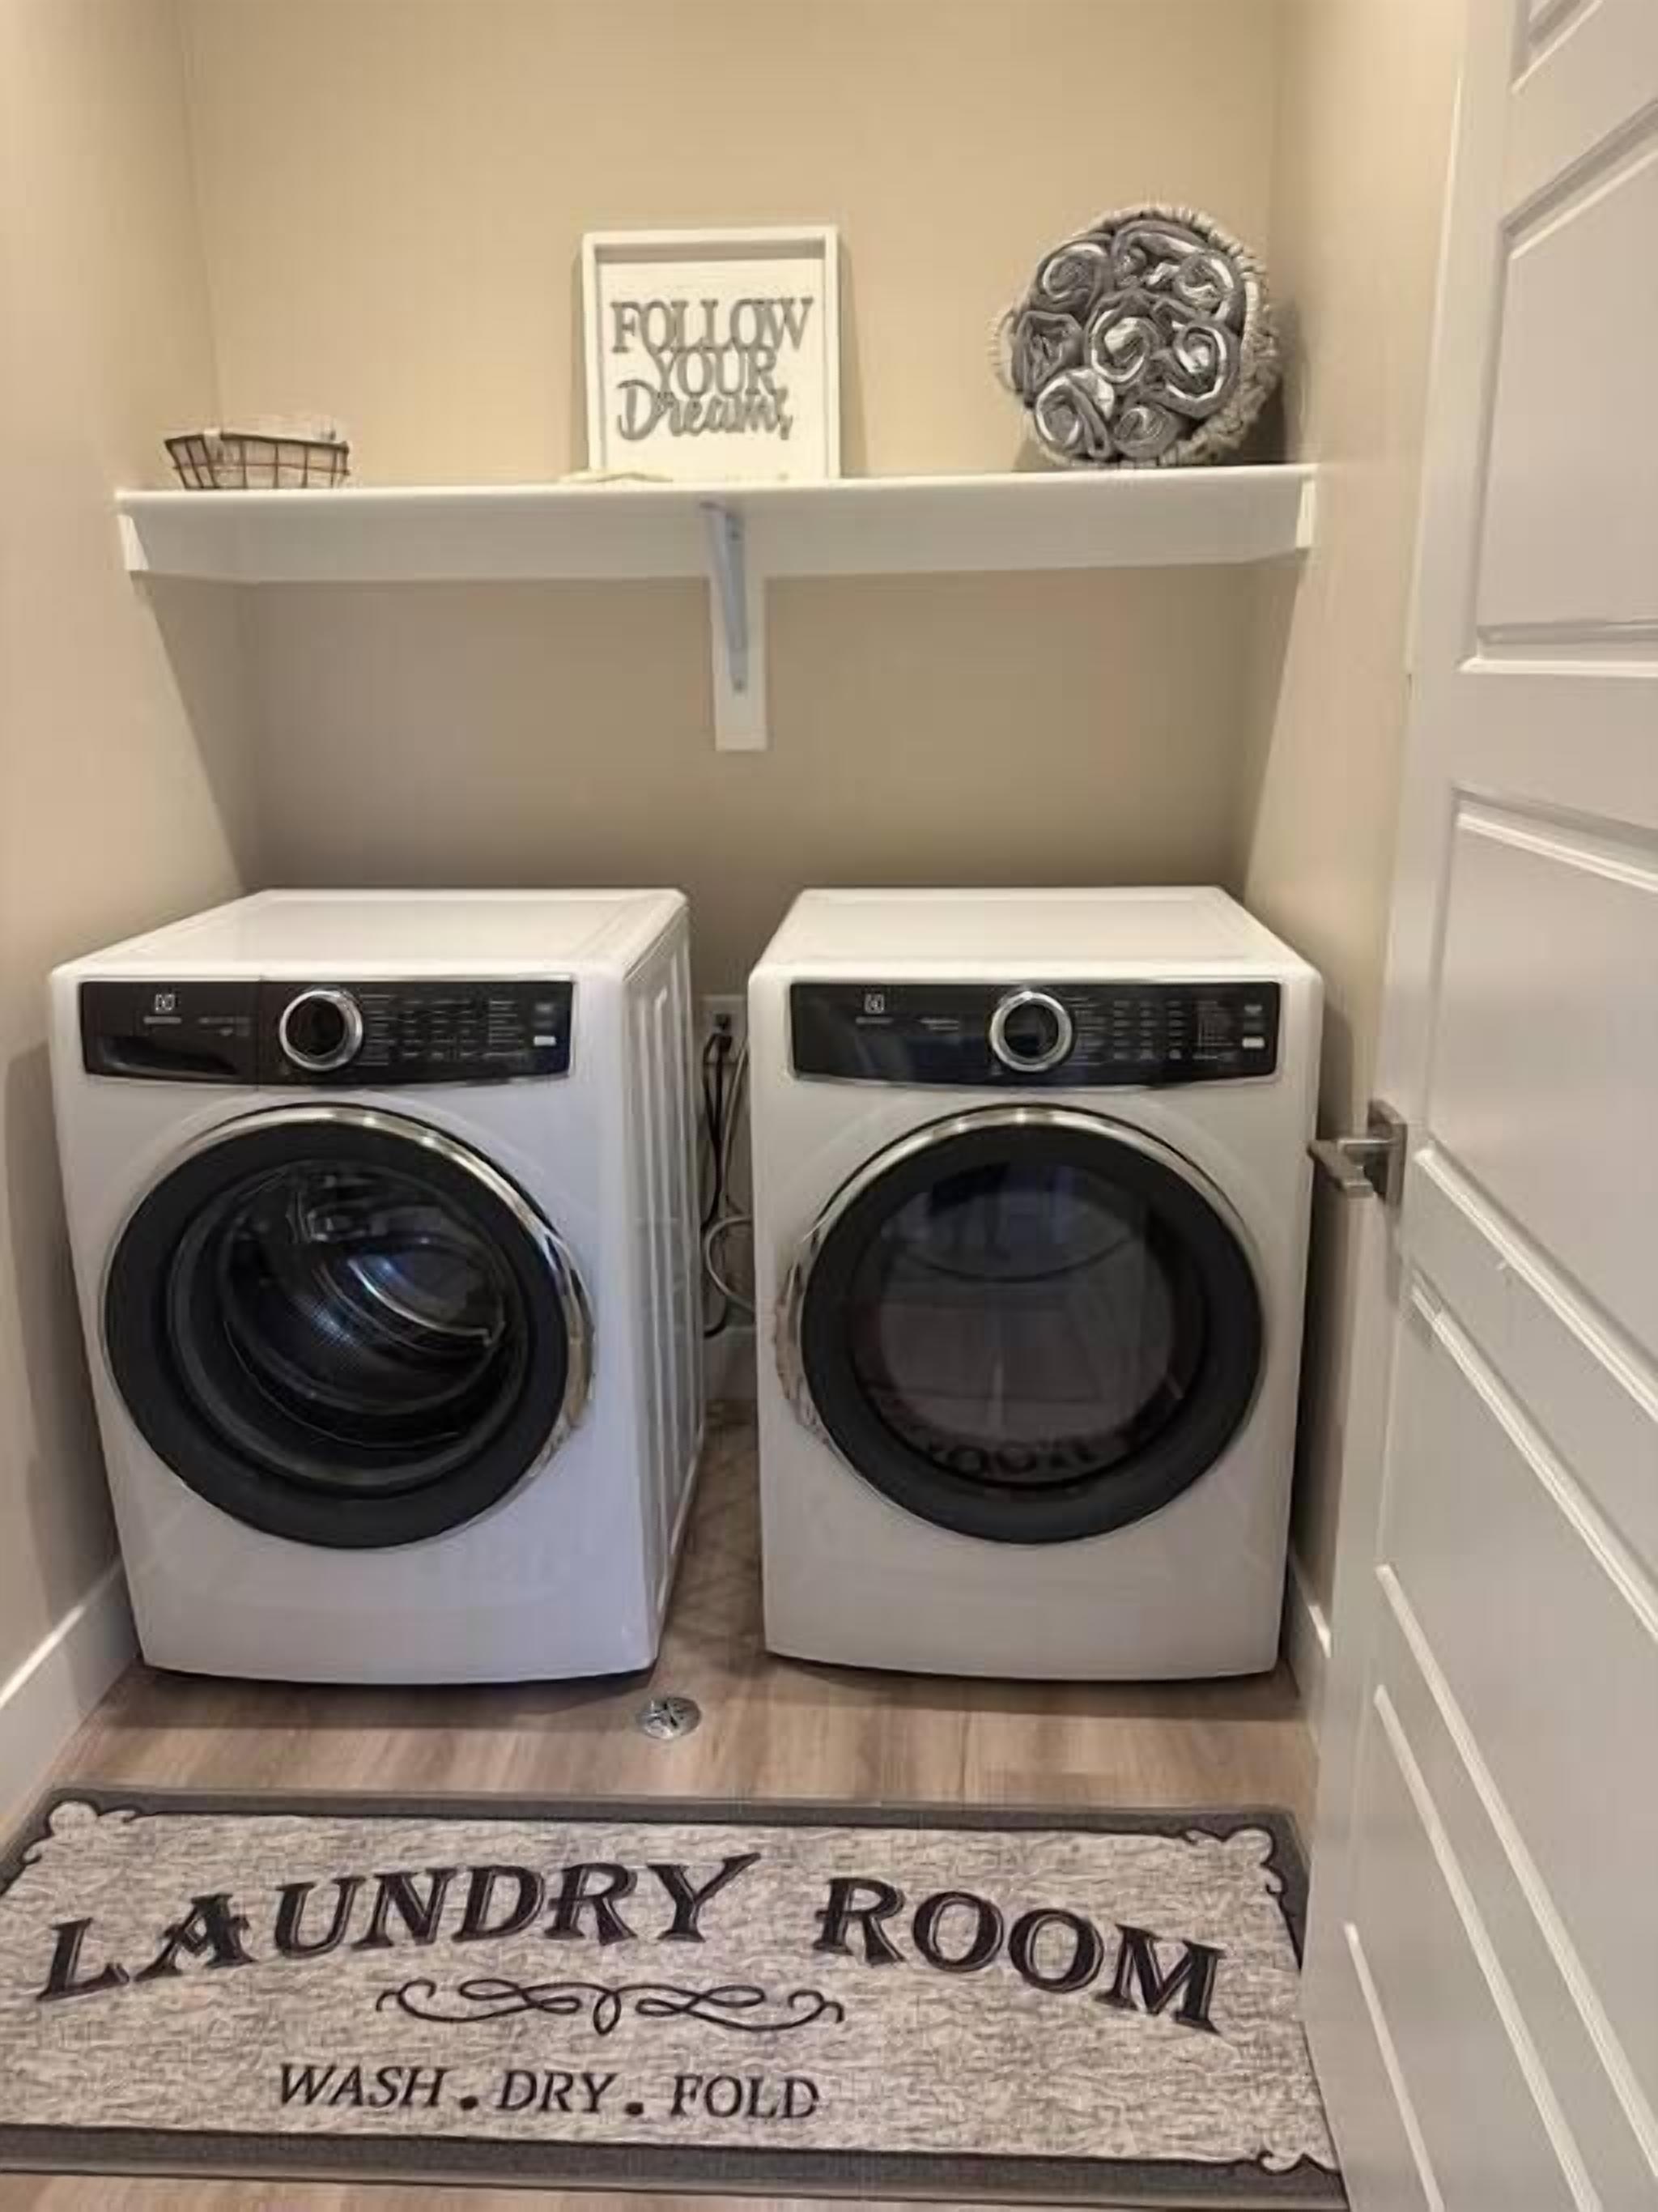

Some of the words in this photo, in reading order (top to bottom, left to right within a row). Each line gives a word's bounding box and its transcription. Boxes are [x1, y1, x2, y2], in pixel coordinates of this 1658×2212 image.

[610, 296, 814, 354] FOLLOW
[650, 347, 778, 396] YOUR
[36, 1853, 762, 2001] LAUNDRY
[814, 1876, 1226, 2035] ROOM
[280, 2062, 455, 2108] WASH
[495, 2069, 619, 2115] DRY
[669, 2074, 821, 2119] FOLD
